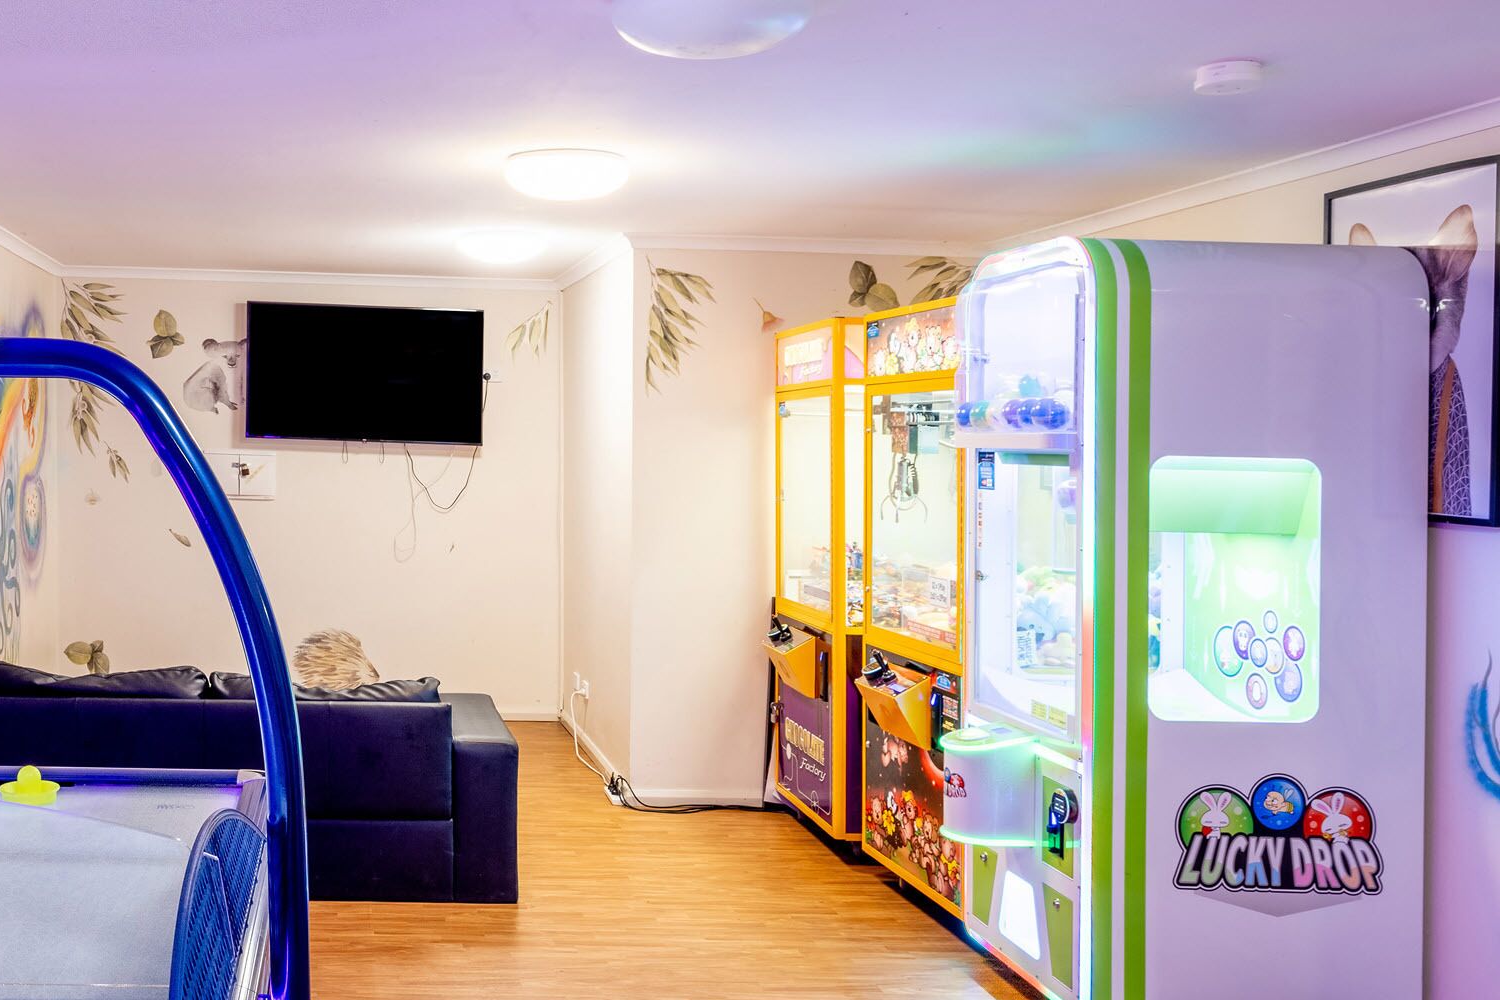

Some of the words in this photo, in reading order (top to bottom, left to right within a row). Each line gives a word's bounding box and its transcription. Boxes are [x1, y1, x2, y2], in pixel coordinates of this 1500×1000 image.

[799, 757, 827, 783] Factory
[1177, 833, 1286, 888] LUCKY
[1288, 836, 1380, 891] DROP
